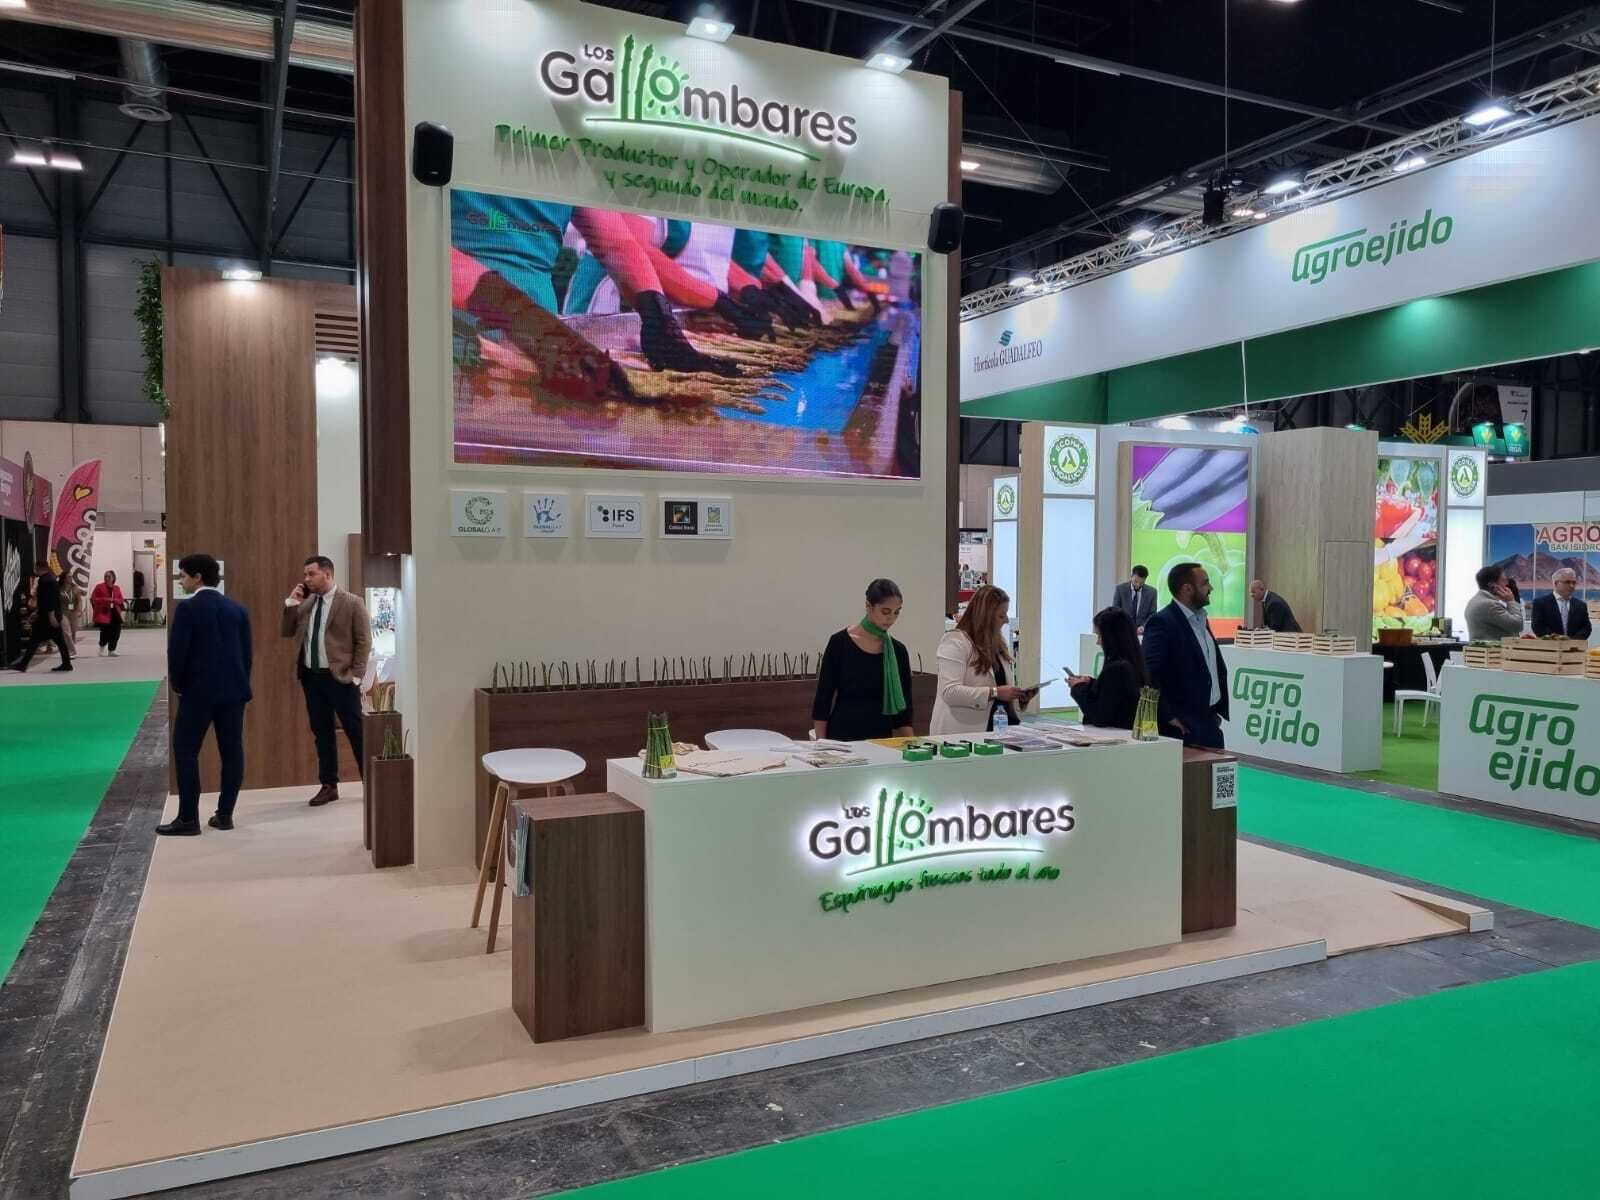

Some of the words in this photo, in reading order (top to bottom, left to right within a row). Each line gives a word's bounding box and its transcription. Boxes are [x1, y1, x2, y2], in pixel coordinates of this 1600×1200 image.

[584, 44, 614, 62] LOS
[541, 34, 857, 146] Gallombares
[495, 123, 571, 152] Primer
[577, 137, 679, 170] Productor
[703, 158, 791, 187] Operador
[622, 171, 701, 198] segundo
[612, 508, 635, 521] IFS
[1246, 708, 1320, 747] ejido
[1488, 746, 1600, 796] ejido
[809, 788, 1075, 865] Gallombares
